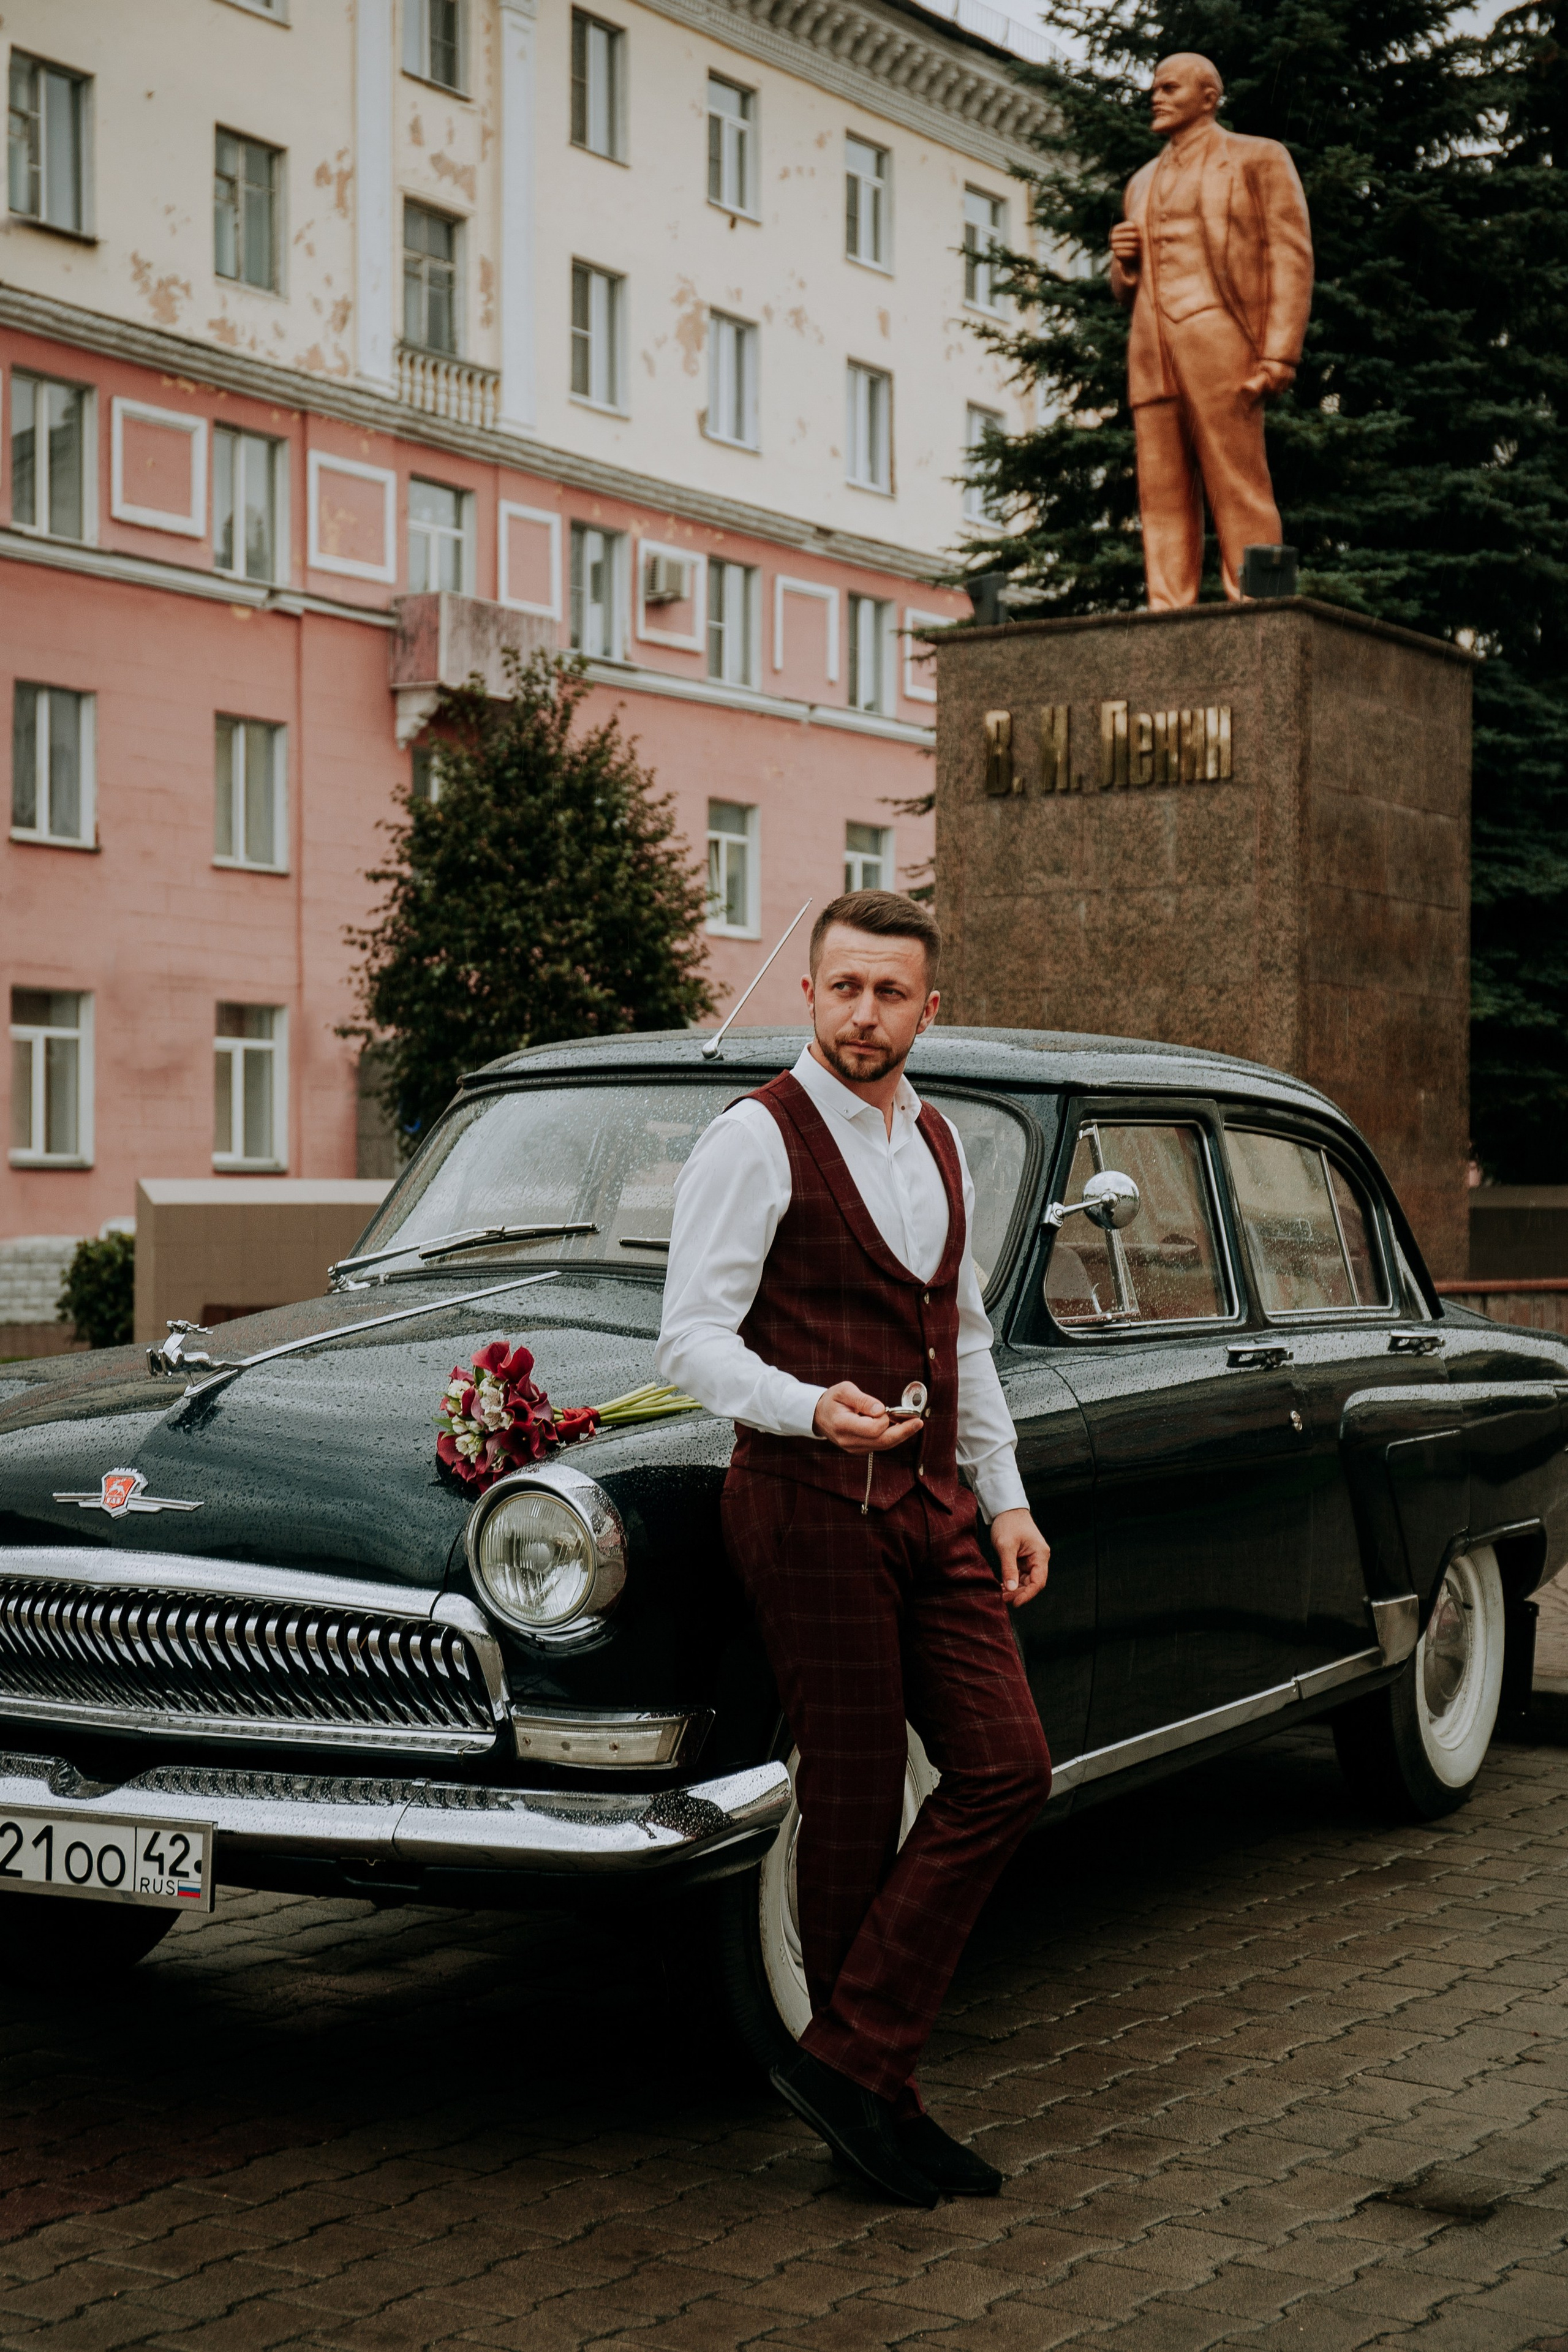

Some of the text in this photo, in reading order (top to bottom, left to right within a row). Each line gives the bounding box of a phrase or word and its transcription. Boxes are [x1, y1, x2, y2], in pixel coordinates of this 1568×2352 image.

[984, 709, 1024, 795] В.
[1100, 700, 1232, 788] Ленин
[143, 1831, 190, 1878] 42
[140, 1877, 175, 1895] RUS
